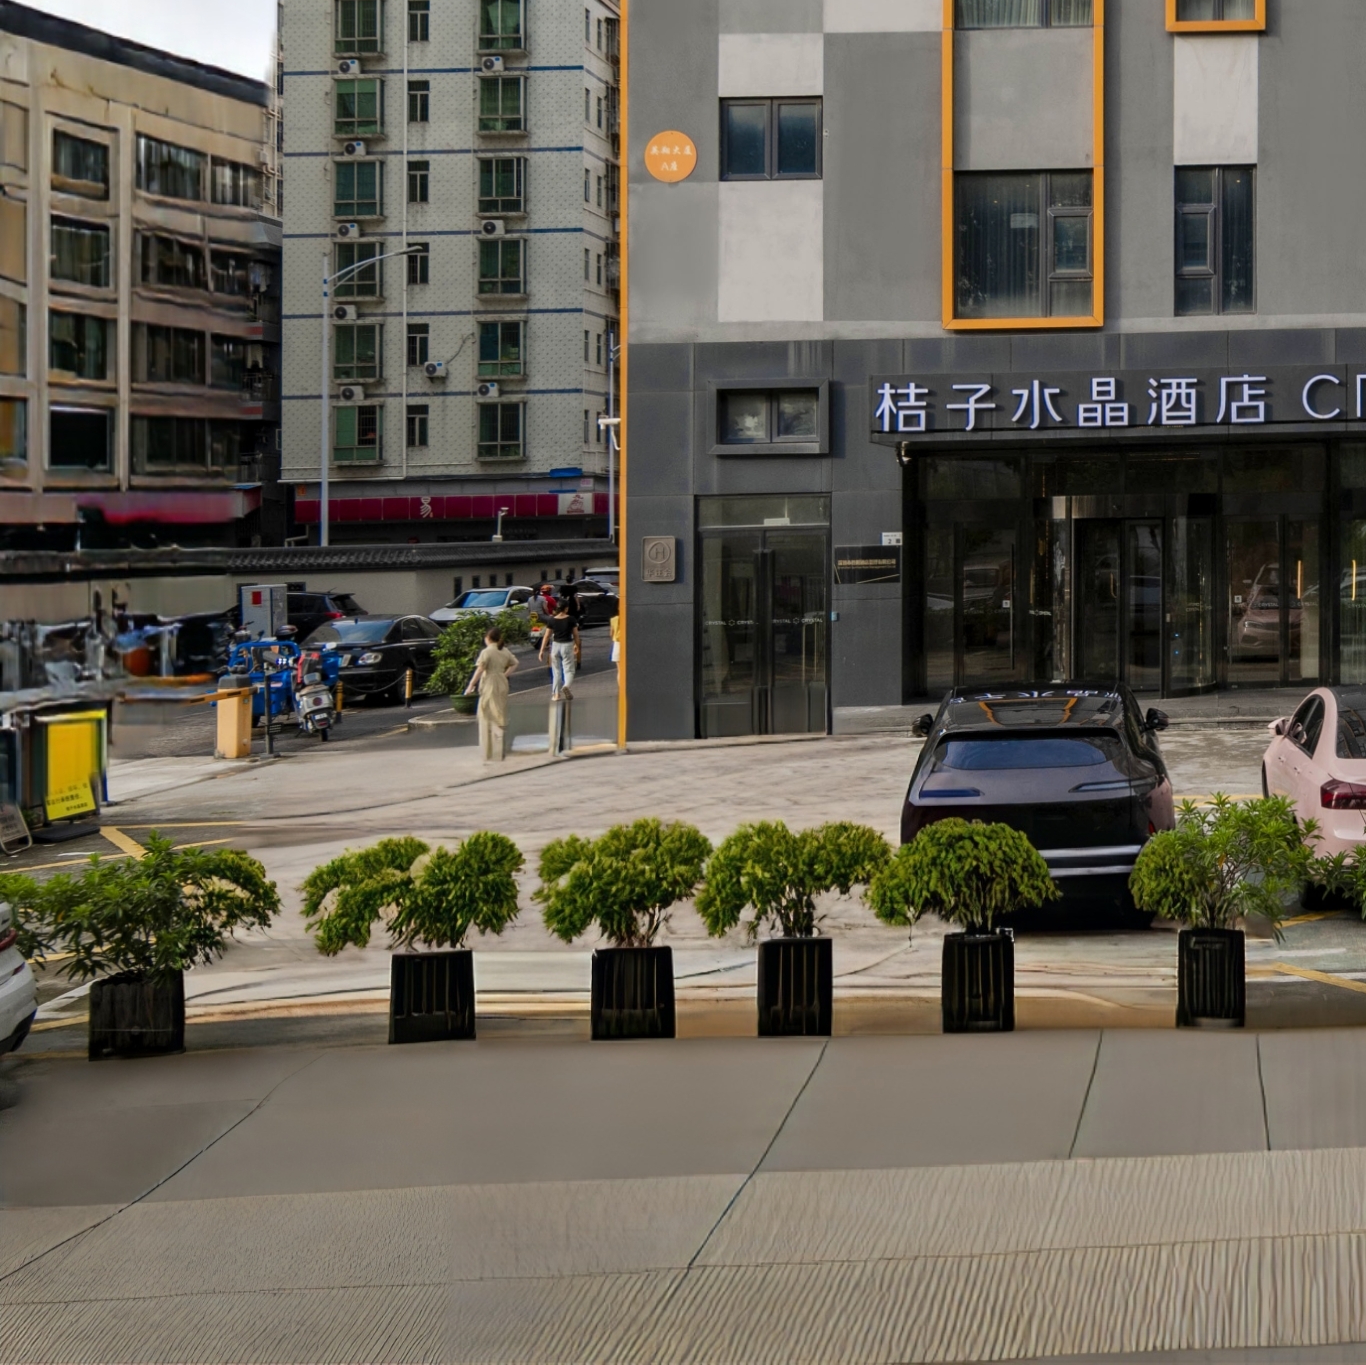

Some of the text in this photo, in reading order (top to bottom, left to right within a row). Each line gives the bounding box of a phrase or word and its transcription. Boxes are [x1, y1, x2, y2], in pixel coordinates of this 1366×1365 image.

[874, 374, 1268, 432] 桔子水晶酒店
